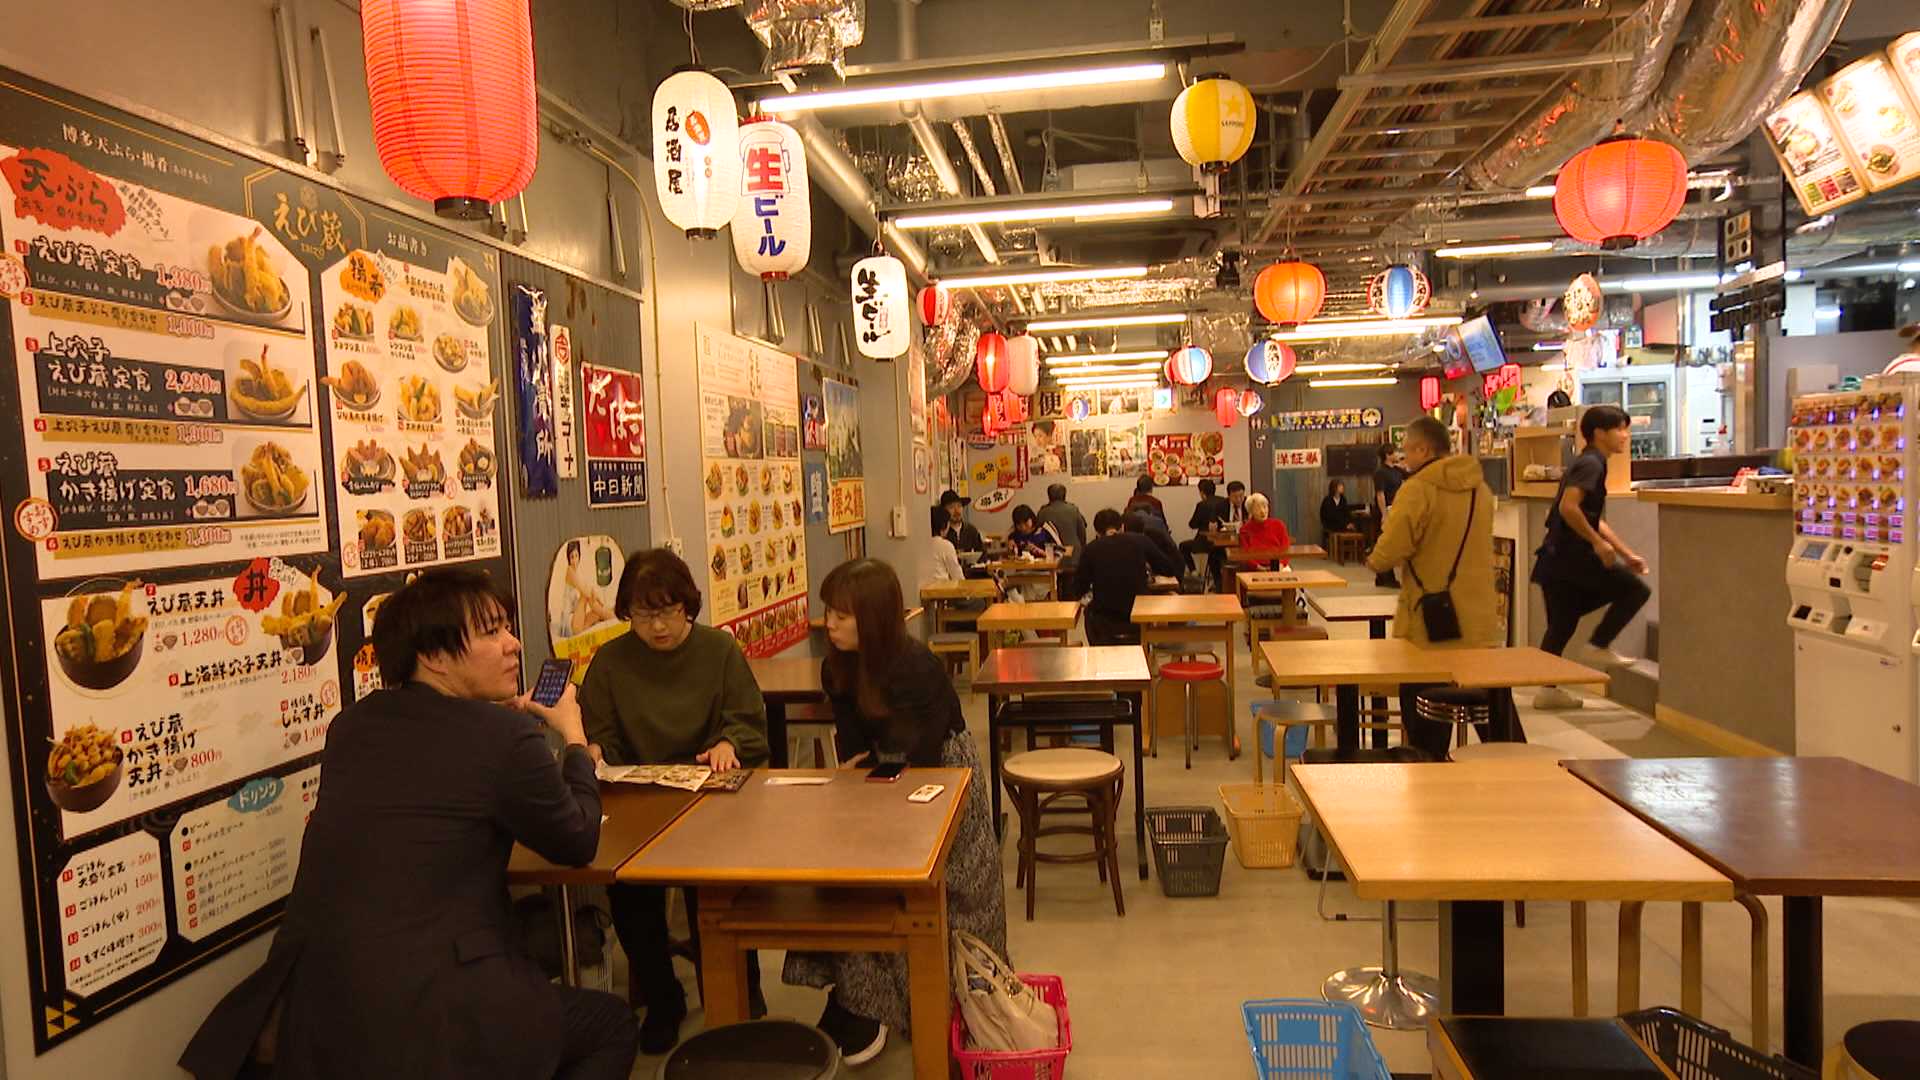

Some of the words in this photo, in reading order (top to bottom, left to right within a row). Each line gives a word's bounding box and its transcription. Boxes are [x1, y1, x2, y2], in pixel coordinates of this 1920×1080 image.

[18, 158, 108, 215] 天ぷら
[748, 148, 786, 256] 生ビール
[274, 192, 346, 254] えび蔵
[56, 452, 118, 476] えび蔵
[593, 473, 644, 497] 中日新聞
[238, 781, 279, 809] ドリンク
